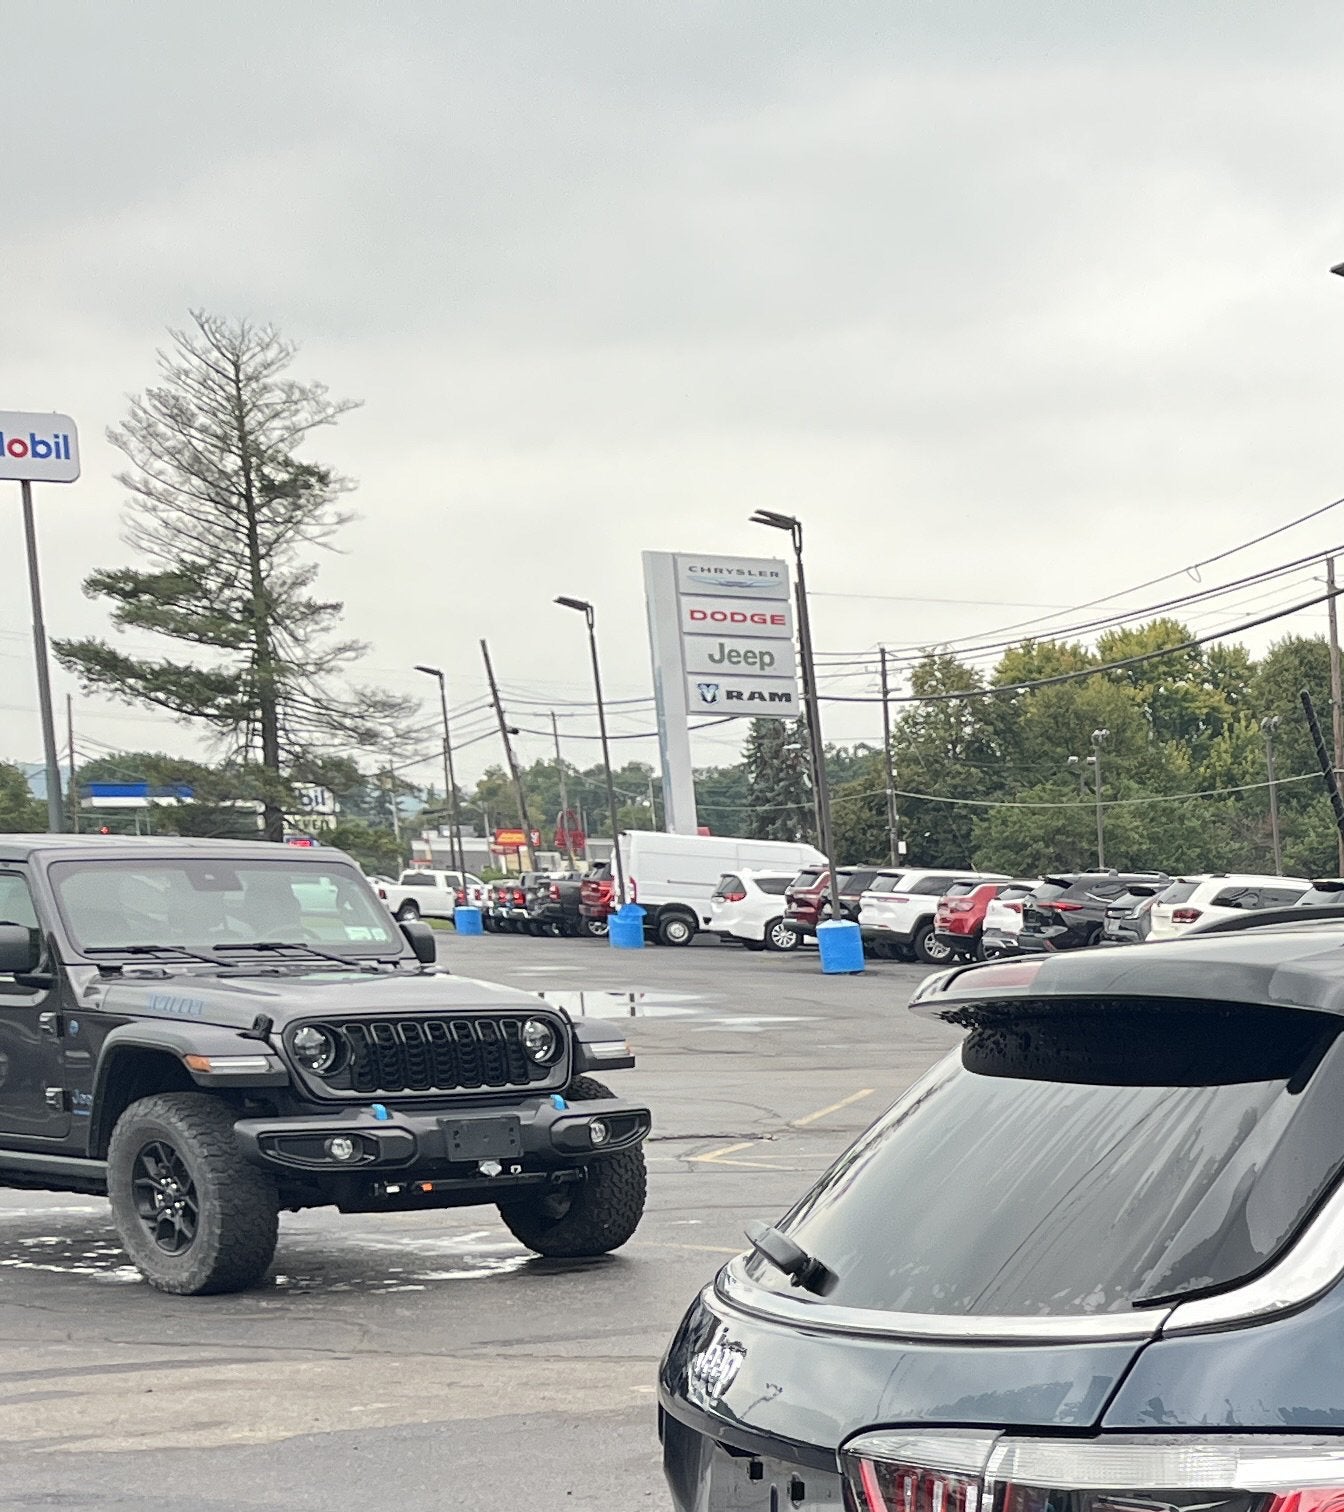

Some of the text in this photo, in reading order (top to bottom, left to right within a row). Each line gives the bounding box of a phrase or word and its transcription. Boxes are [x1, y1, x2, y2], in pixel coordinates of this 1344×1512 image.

[0, 431, 70, 460] obil
[688, 565, 780, 578] CHRYSLER
[689, 609, 786, 626] DODGE
[707, 642, 775, 671] Jeep
[725, 690, 792, 703] RAM
